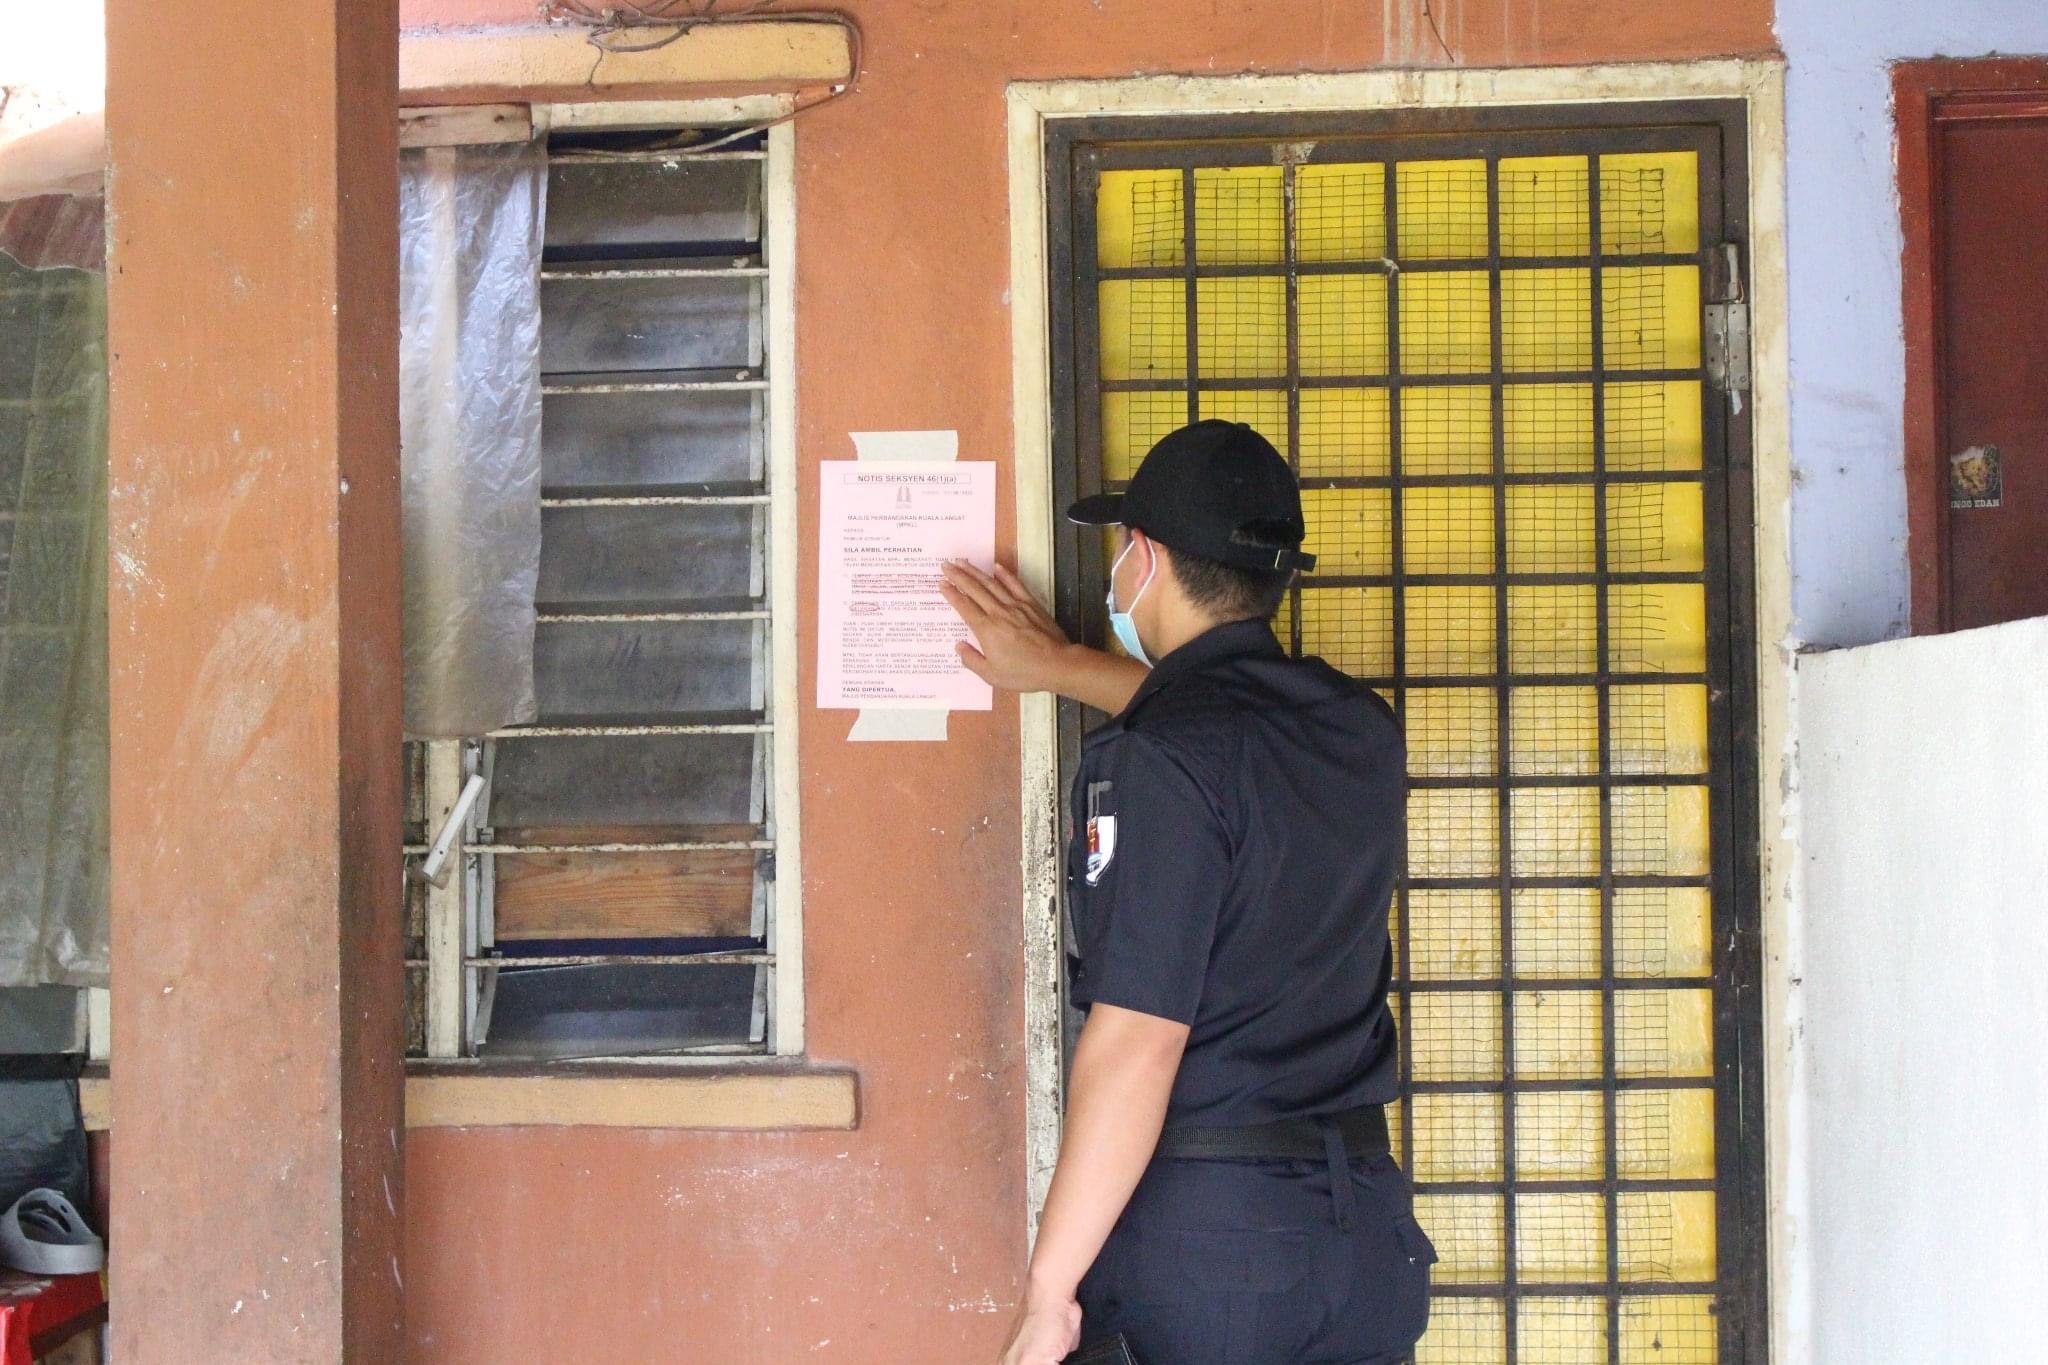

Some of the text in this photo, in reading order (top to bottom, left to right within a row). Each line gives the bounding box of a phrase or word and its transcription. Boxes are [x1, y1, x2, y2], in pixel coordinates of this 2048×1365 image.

[858, 475, 957, 484] NOTIS SEKSYEN 46(1)(a)
